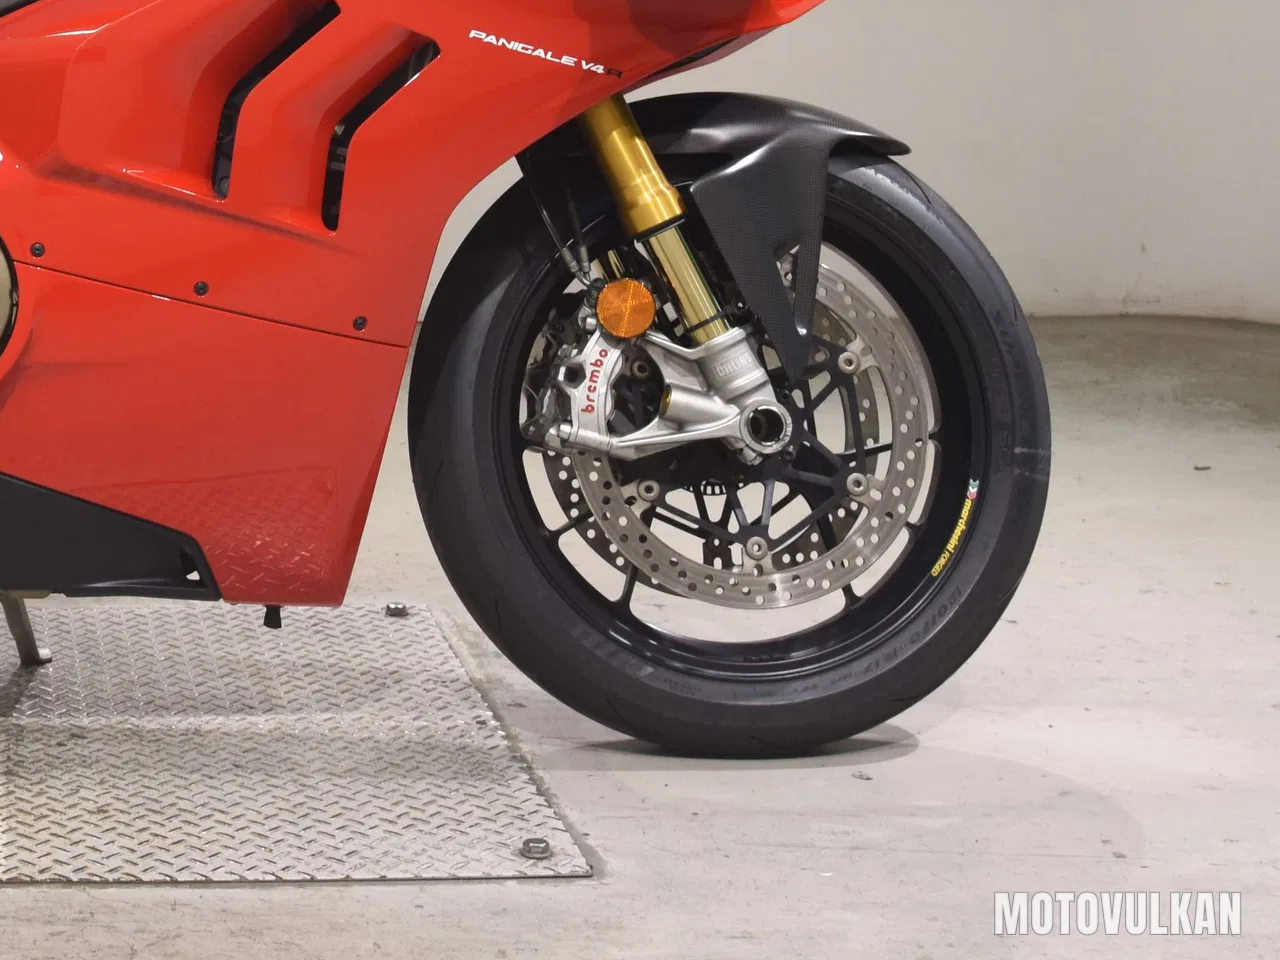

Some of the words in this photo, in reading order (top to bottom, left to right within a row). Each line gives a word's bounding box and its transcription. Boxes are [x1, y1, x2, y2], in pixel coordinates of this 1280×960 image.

[469, 30, 578, 66] PANIGALE
[581, 60, 605, 74] V4
[581, 348, 608, 414] brembo
